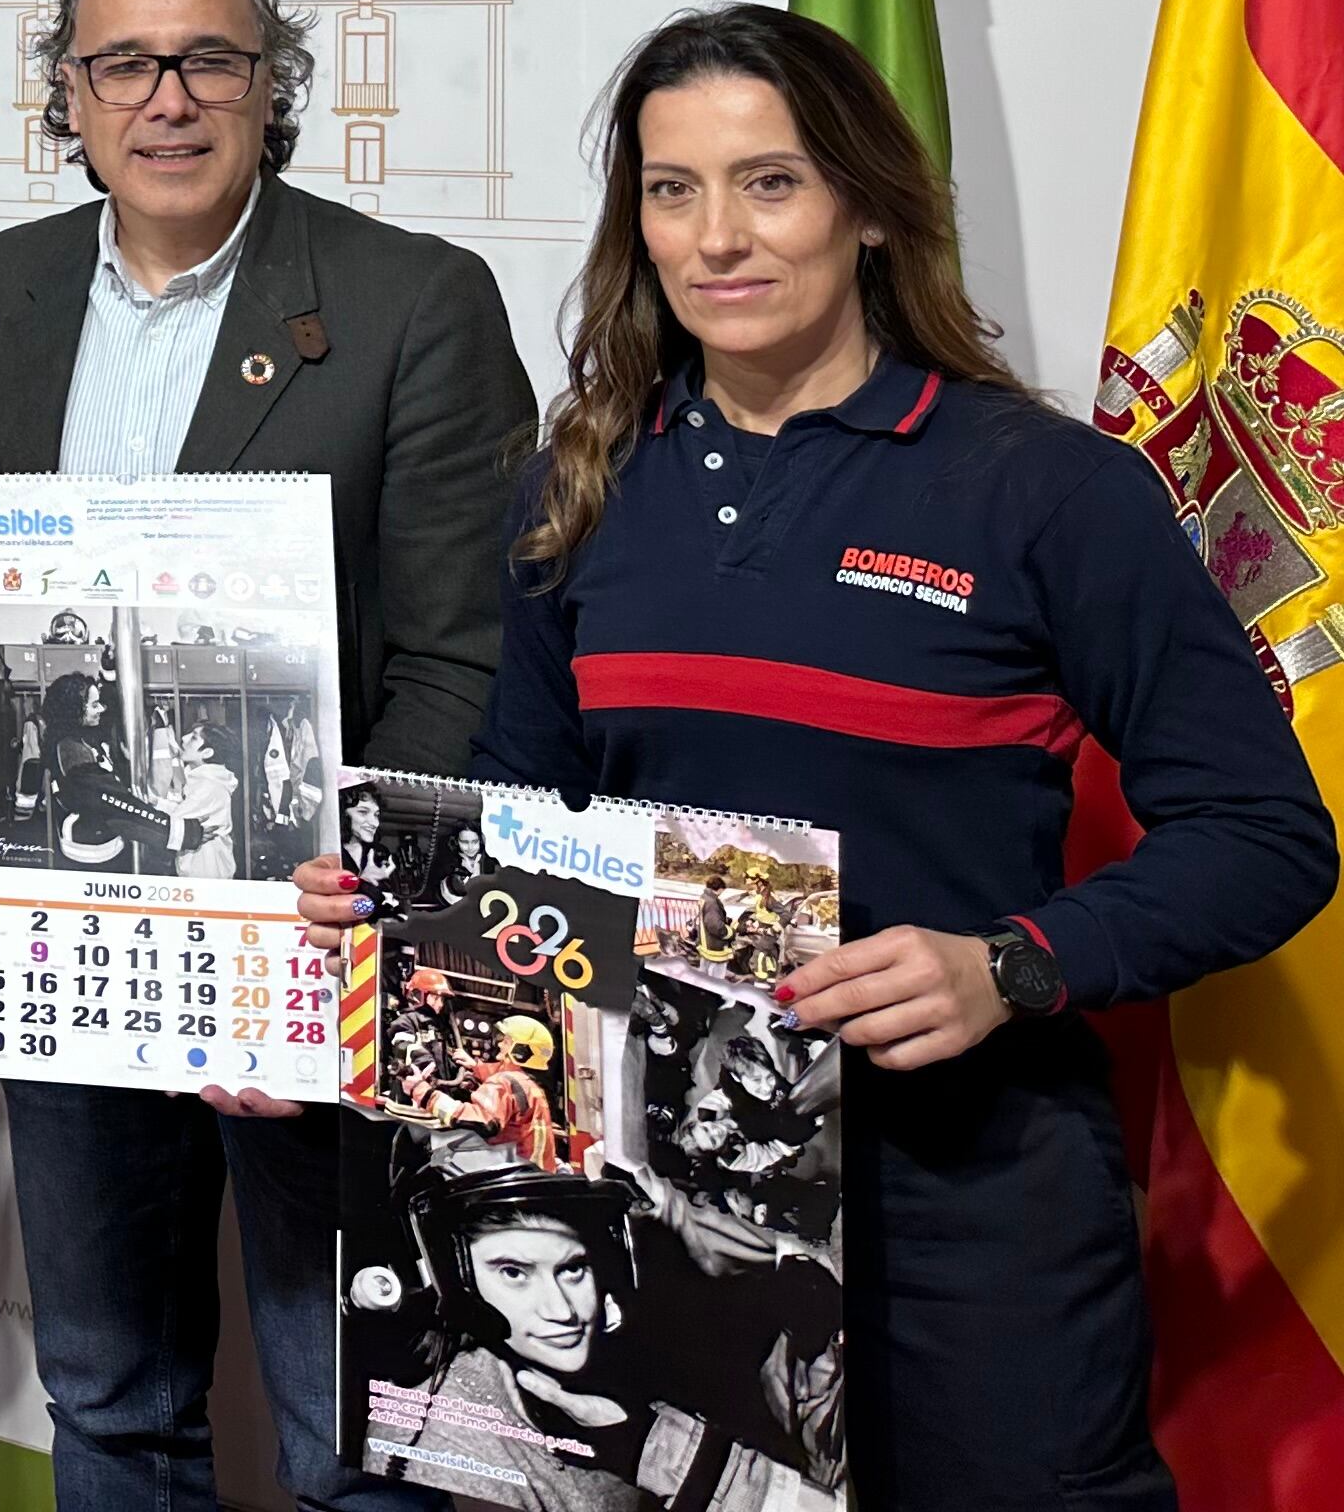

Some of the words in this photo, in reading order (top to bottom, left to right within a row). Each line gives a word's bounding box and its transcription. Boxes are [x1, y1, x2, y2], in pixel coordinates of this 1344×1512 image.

[836, 569, 912, 596] CONSORCIO
[915, 584, 968, 614] SEGURA
[840, 547, 975, 597] BOMBEROS
[154, 653, 168, 664] B1
[84, 882, 142, 899] JUNIO
[147, 886, 194, 902] 2026
[30, 910, 49, 932] 2
[82, 914, 100, 936] 3
[134, 918, 153, 939] 4
[187, 920, 206, 943] 5
[240, 923, 260, 946] 6
[479, 889, 594, 989] 2026
[30, 941, 49, 963] 9
[73, 944, 110, 967] 10
[125, 947, 158, 971] 11
[178, 951, 216, 975] 12
[232, 954, 269, 978] 13
[286, 956, 324, 980] 14
[21, 971, 58, 994] 16
[73, 974, 110, 998] 17
[125, 978, 163, 1002] 18
[178, 982, 217, 1006] 19
[231, 985, 271, 1009] 20
[285, 988, 326, 1012] 21
[19, 1002, 57, 1025] 23
[71, 1005, 110, 1029] 24
[123, 1009, 162, 1033] 25
[177, 1013, 217, 1038] 26
[232, 1017, 270, 1041] 27
[286, 1020, 326, 1045] 28
[19, 1033, 57, 1057] 30
[370, 1381, 430, 1403] Diferente
[432, 1395, 448, 1408] en
[451, 1399, 463, 1410] el
[467, 1403, 502, 1418] vuelo
[370, 1411, 422, 1430] Adriana
[370, 1398, 398, 1414] pero
[401, 1404, 425, 1416] con
[429, 1407, 441, 1419] el
[444, 1412, 488, 1431] mismo
[491, 1419, 545, 1445] derecho
[370, 1438, 526, 1485] www.masvisibles.com
